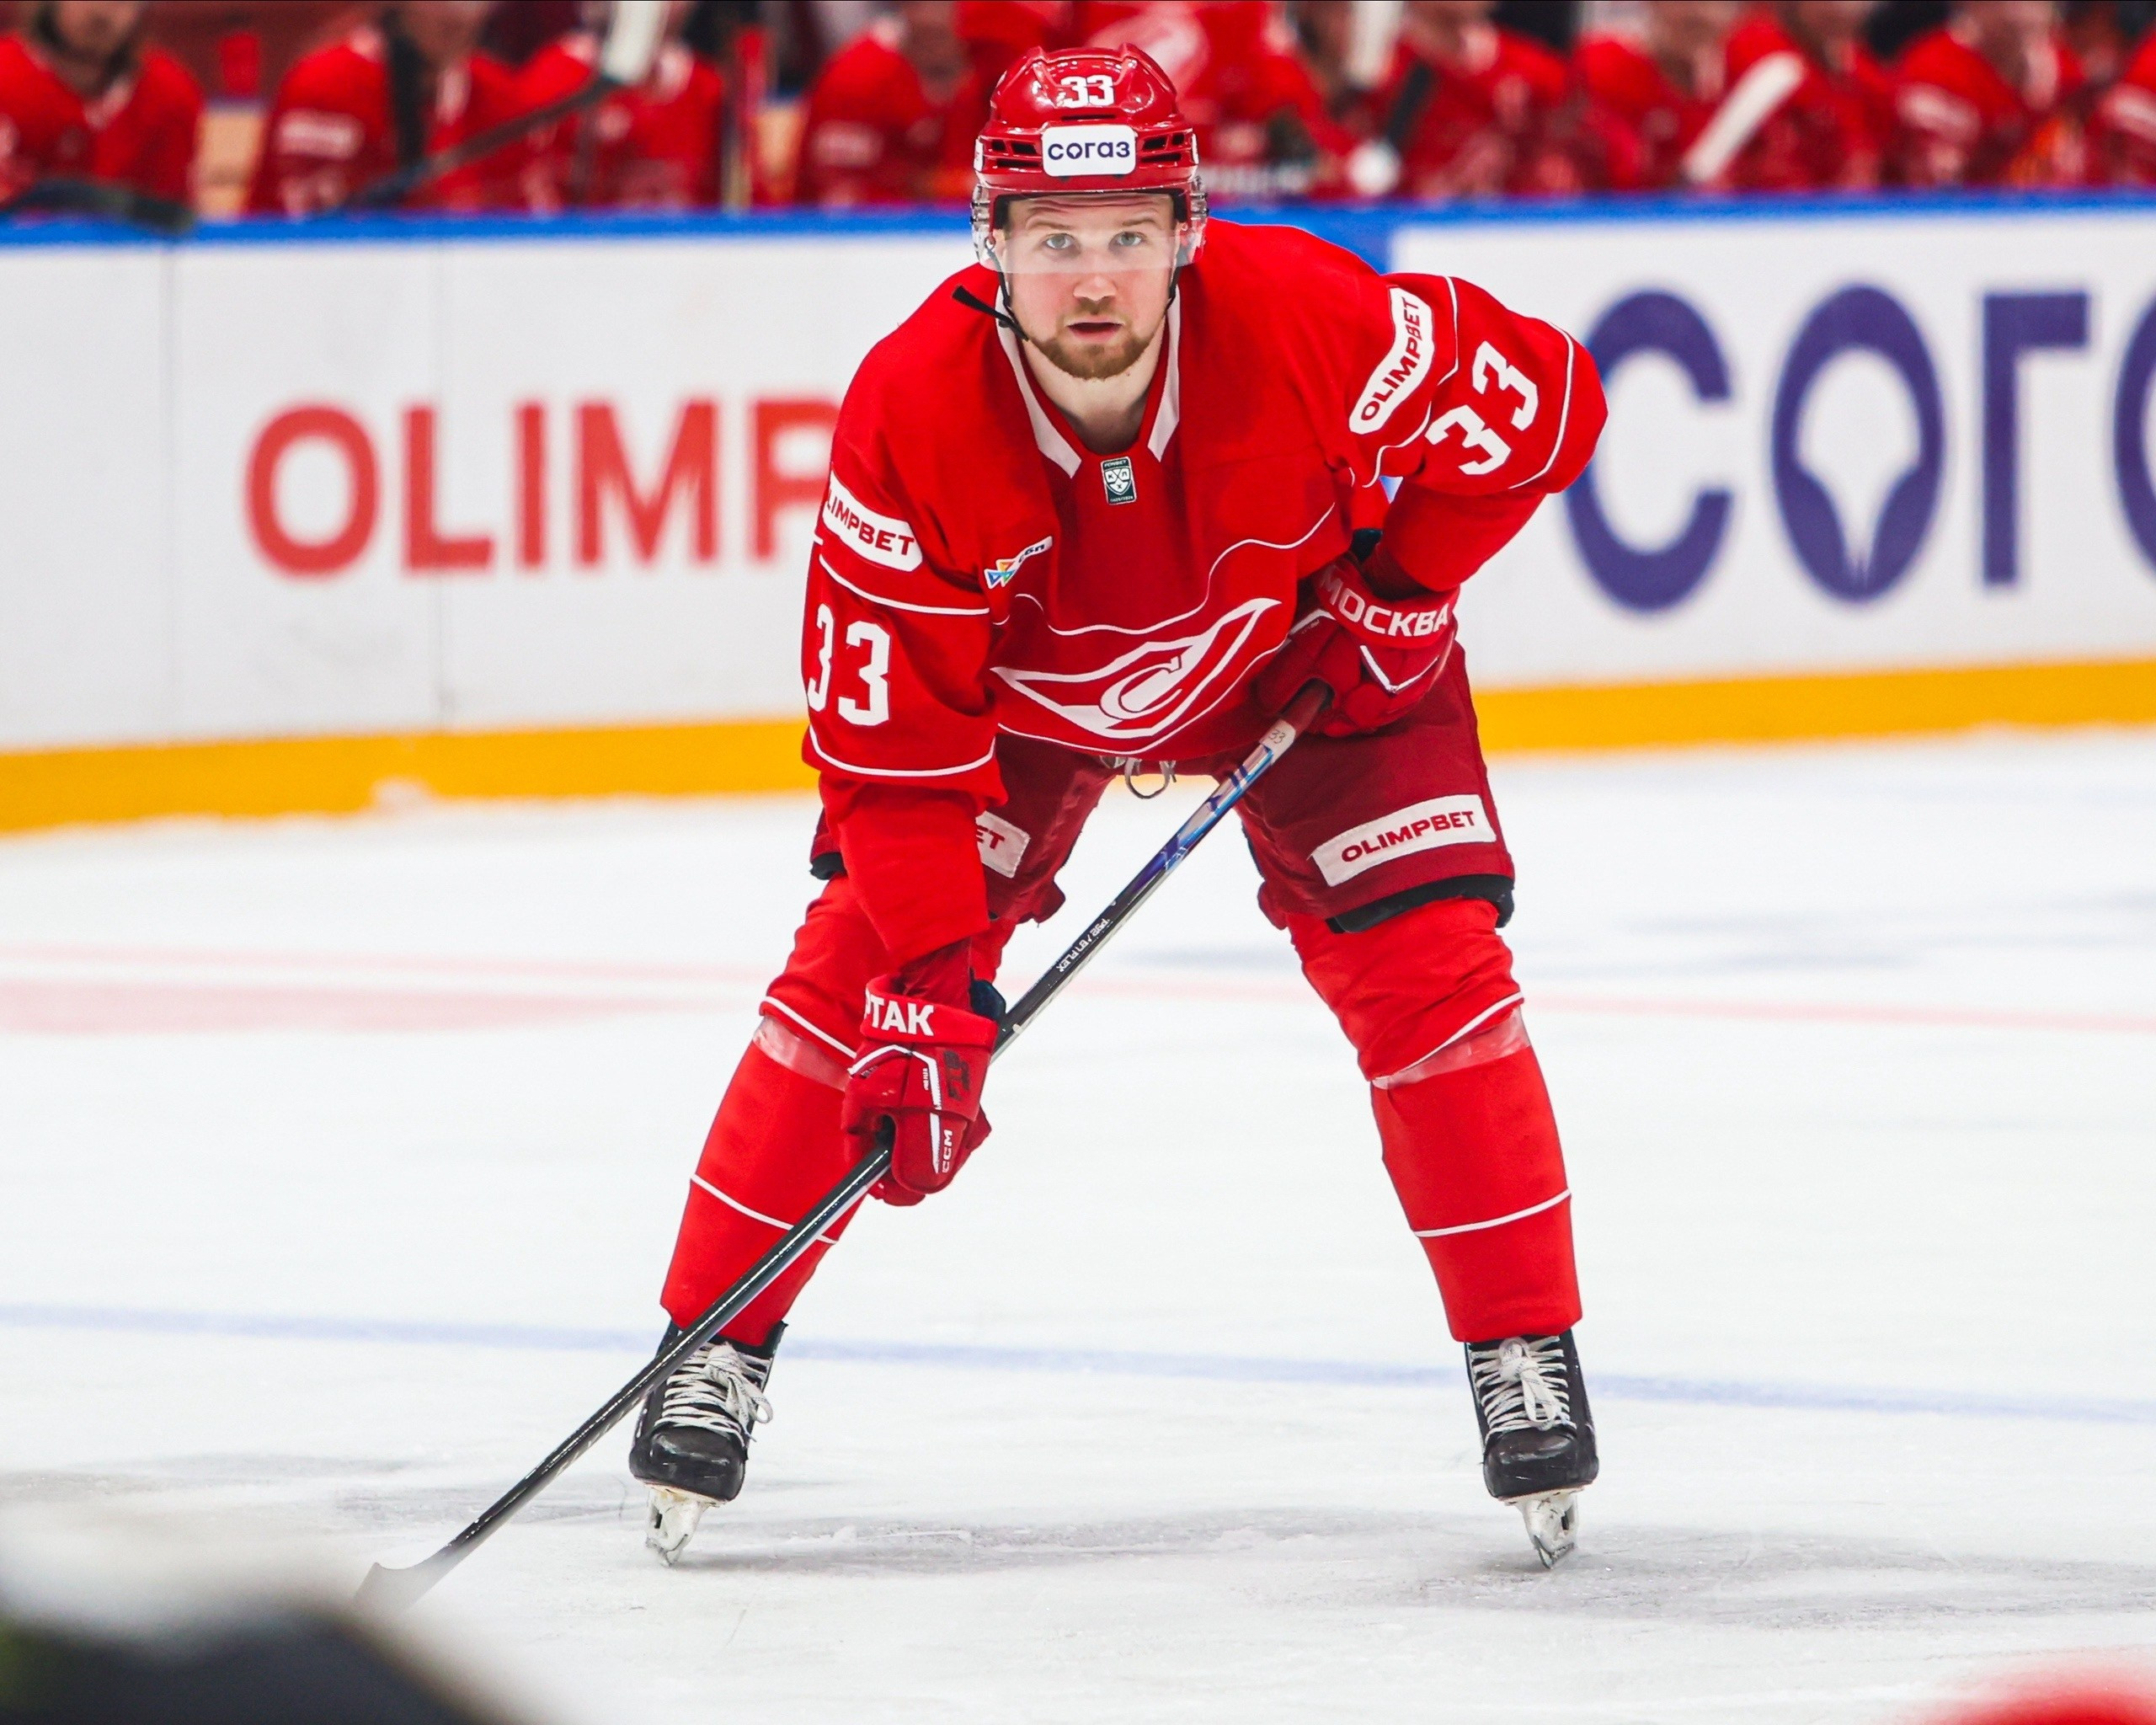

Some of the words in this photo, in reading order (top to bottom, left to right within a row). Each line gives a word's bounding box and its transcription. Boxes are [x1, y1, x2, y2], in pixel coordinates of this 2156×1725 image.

[1059, 75, 1114, 108] 33
[1048, 141, 1130, 161] согаз
[1361, 296, 1422, 421] OLIMPBET
[1424, 339, 1539, 475] 33
[1564, 284, 2156, 613] сог
[1320, 564, 1449, 637] МОСКВА
[807, 604, 890, 726] 33
[1268, 729, 1285, 744] 33
[1342, 811, 1476, 862] OLIMPBET
[1056, 949, 1079, 972] FLEX
[942, 1130, 953, 1173] CCM
